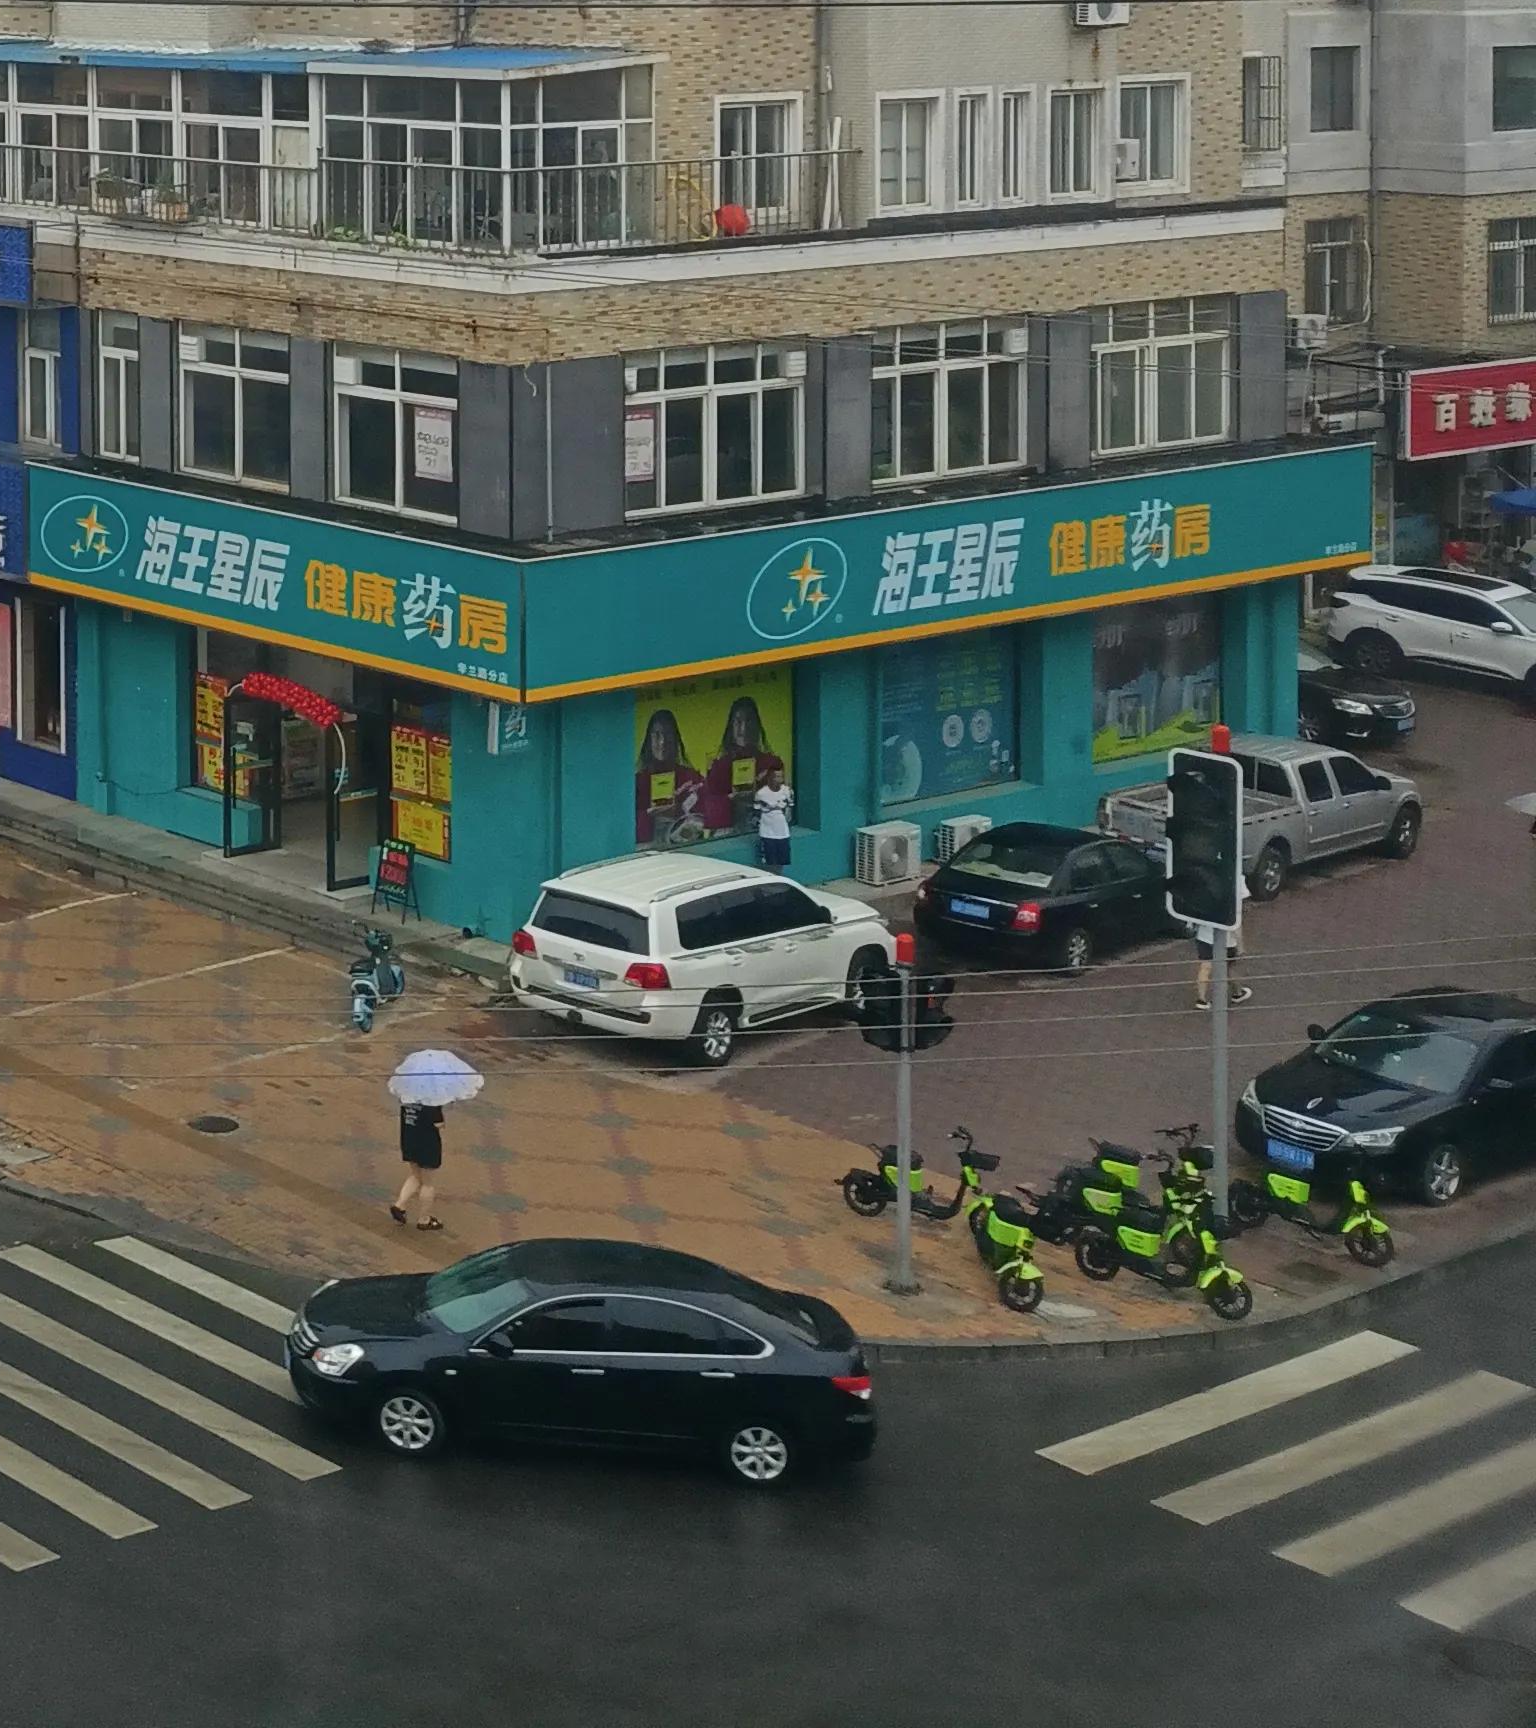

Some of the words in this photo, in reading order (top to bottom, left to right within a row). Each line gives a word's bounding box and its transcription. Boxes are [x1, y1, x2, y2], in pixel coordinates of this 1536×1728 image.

[135, 515, 291, 612] 海王星辰
[304, 558, 509, 655] 健康药房
[872, 517, 1025, 616] 海王星辰
[1048, 499, 1212, 576] 健康药房
[504, 706, 528, 740] 药
